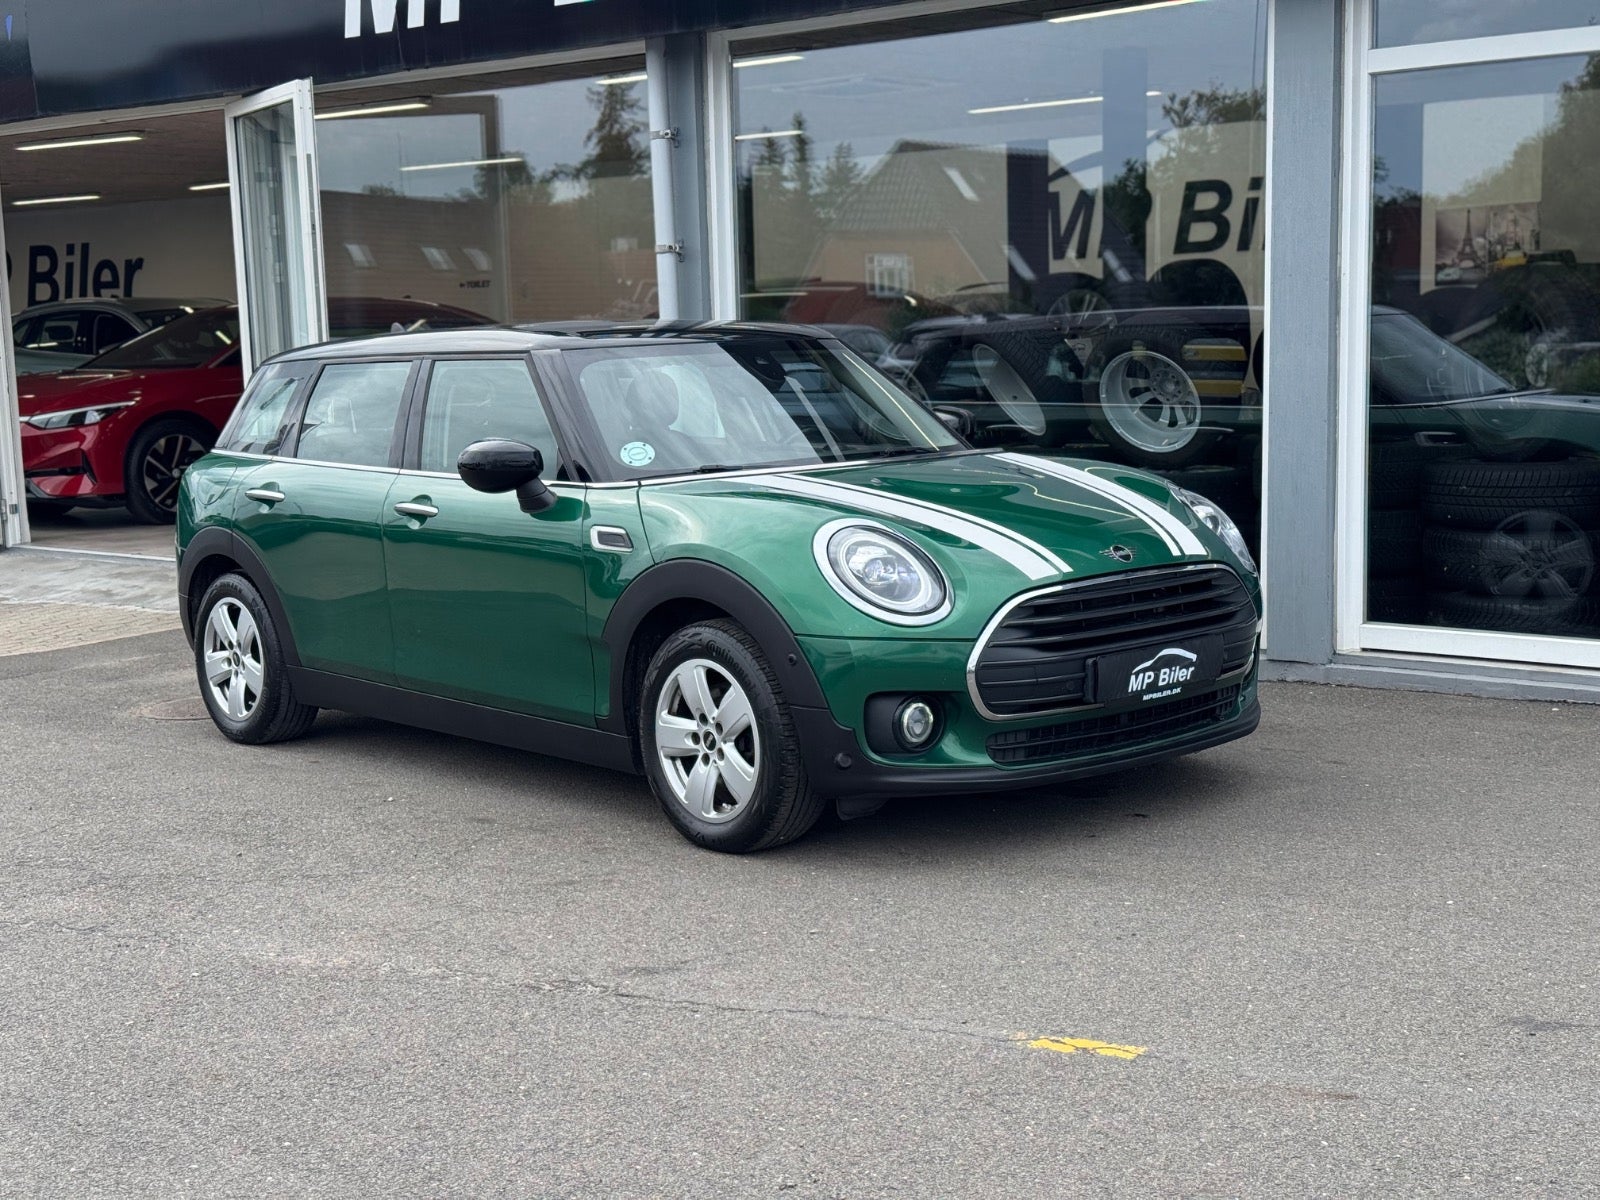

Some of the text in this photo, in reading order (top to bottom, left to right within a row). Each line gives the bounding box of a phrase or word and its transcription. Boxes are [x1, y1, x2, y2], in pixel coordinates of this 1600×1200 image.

[1173, 176, 1265, 254] Bi
[28, 243, 144, 308] Biler
[1128, 666, 1195, 692] MP Biler
